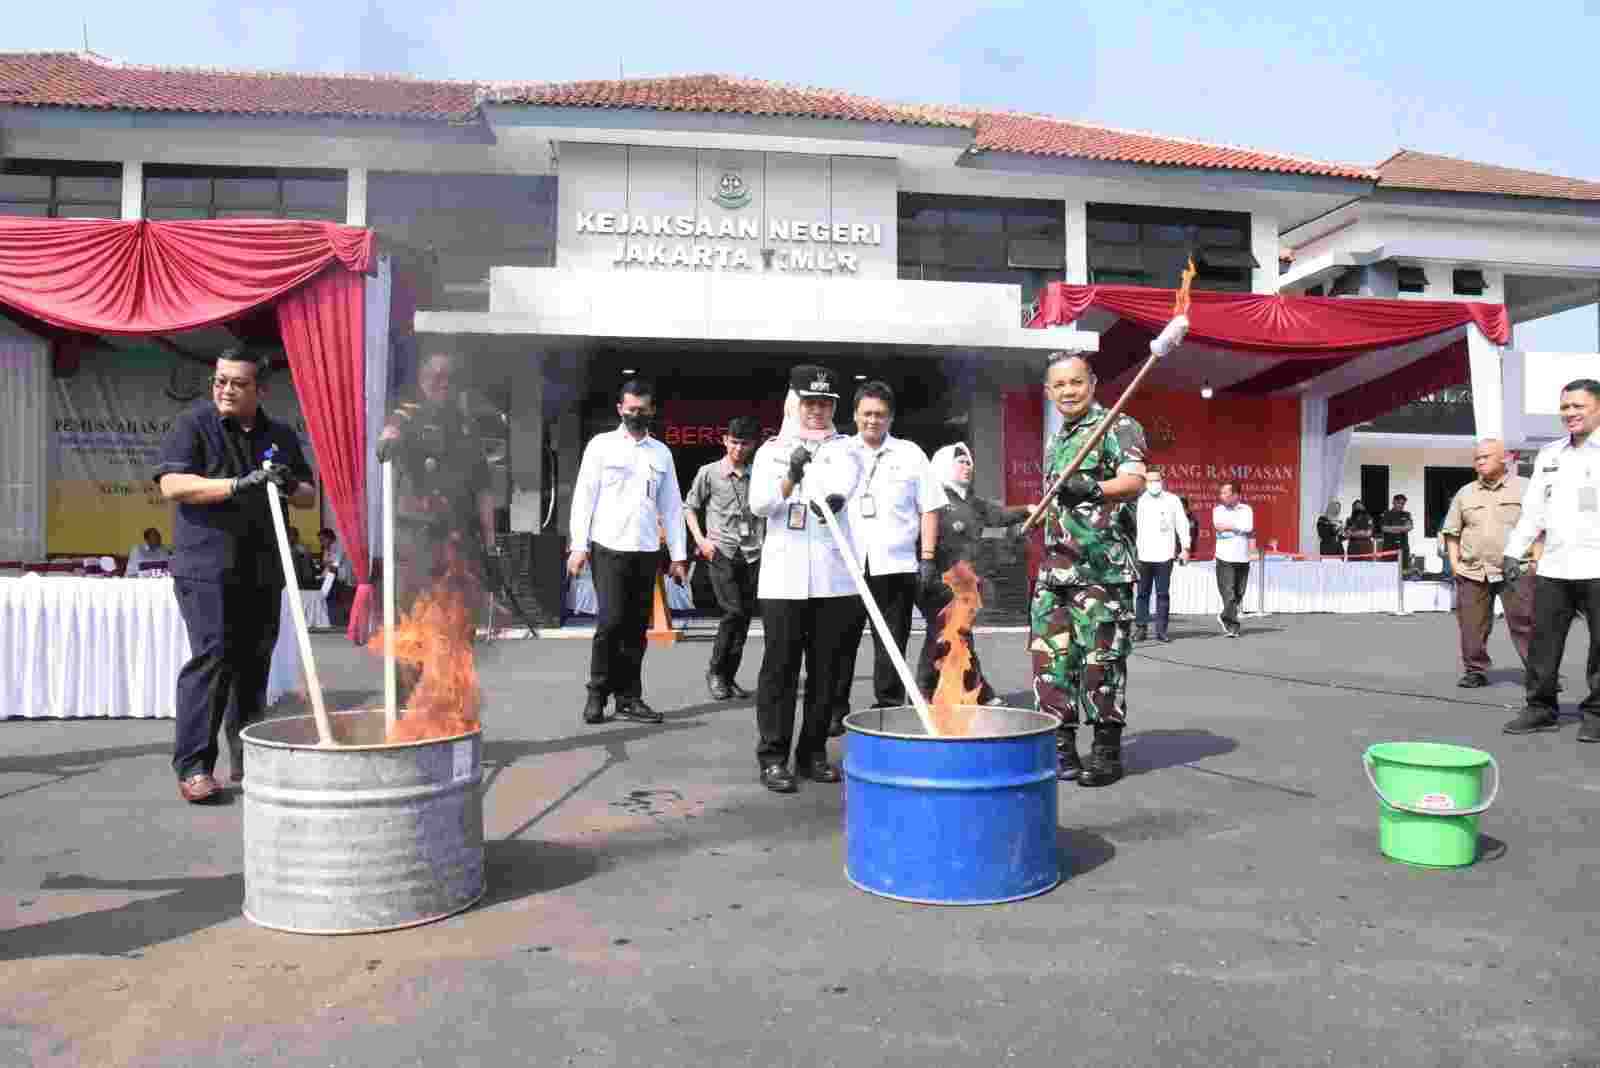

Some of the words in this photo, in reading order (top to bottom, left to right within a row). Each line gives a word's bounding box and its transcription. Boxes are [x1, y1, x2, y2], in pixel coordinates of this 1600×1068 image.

[575, 210, 760, 240] KEJAKSAAN
[768, 219, 882, 246] NEGERI
[613, 242, 752, 270] JAKARTA
[1206, 463, 1295, 481] RAMPASAN
